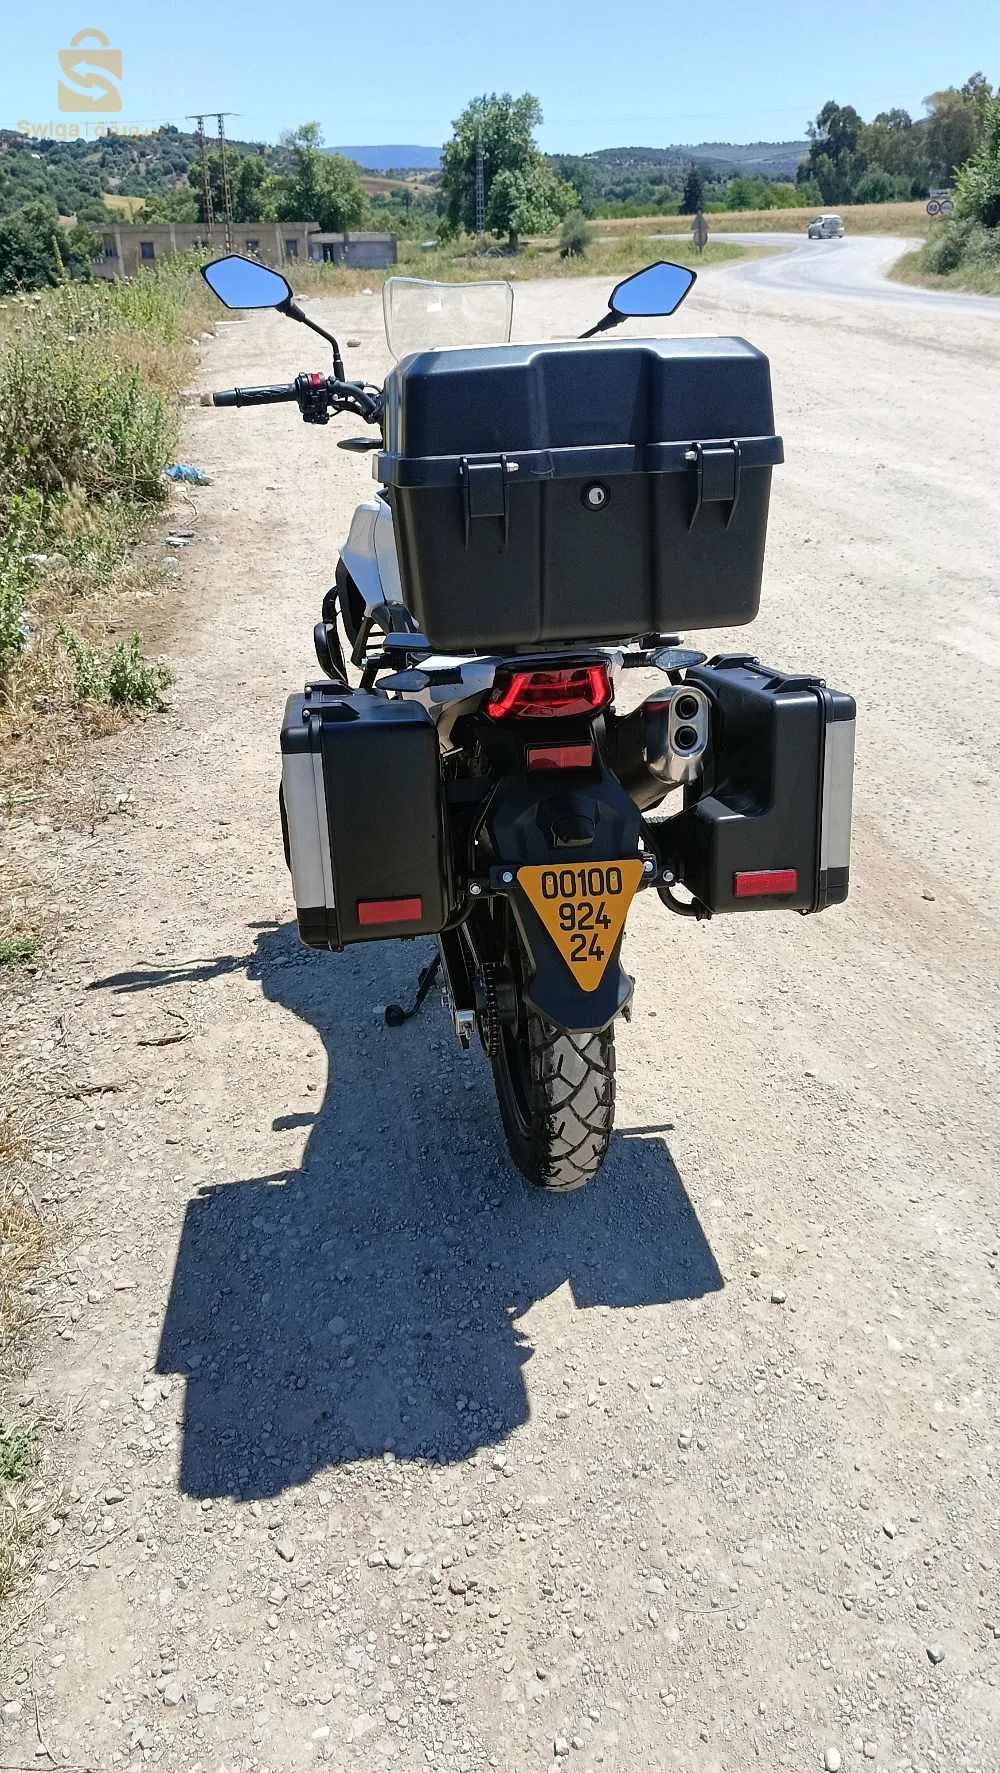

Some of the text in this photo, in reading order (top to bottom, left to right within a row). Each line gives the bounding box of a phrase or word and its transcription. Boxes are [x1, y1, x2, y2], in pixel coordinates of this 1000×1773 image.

[541, 867, 623, 899] 00100
[558, 901, 612, 931] 924
[570, 933, 605, 962] 24
